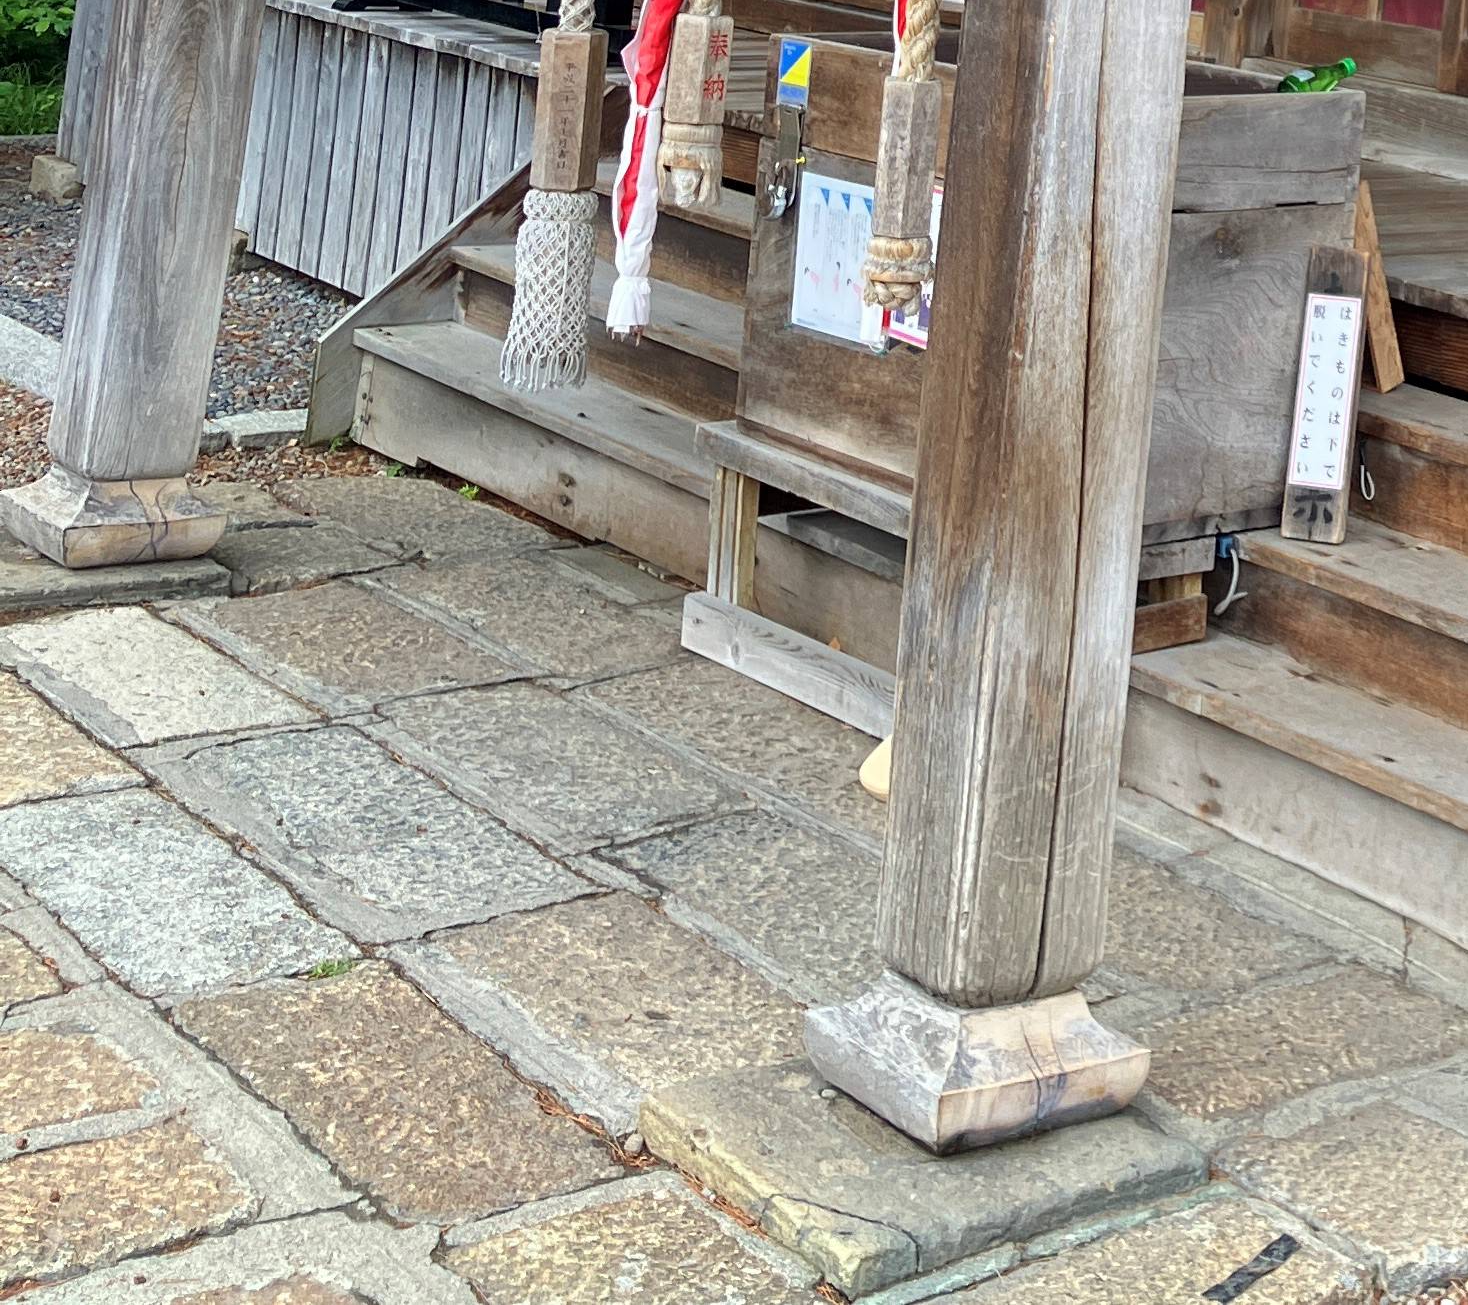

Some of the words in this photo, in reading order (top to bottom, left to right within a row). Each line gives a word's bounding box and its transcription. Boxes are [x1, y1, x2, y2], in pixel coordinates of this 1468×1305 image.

[1296, 303, 1327, 476] 脱いでください
[1323, 304, 1352, 480] はきものは下で
